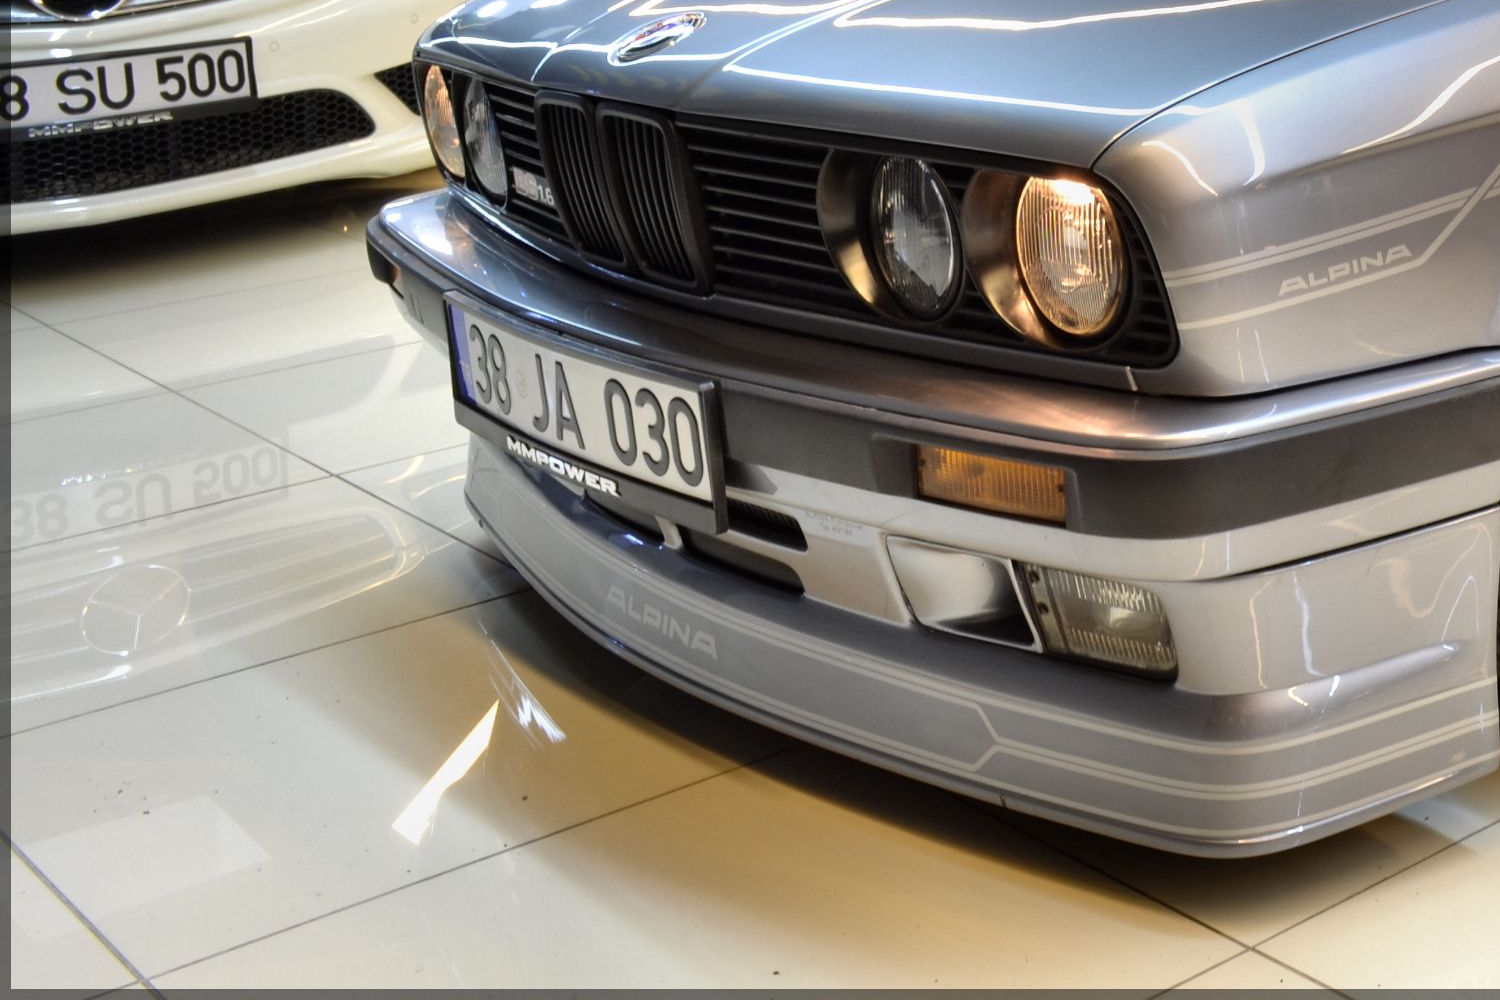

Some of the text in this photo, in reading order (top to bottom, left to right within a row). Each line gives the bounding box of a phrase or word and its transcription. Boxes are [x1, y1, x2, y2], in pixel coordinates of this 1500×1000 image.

[56, 62, 135, 115] SU
[156, 49, 246, 102] 500
[28, 111, 174, 138] MMPOWER
[1278, 244, 1412, 297] ALPINA
[469, 324, 704, 487] 38 JA 030
[507, 435, 621, 498] MMPOWER
[606, 585, 718, 661] ALPINA
